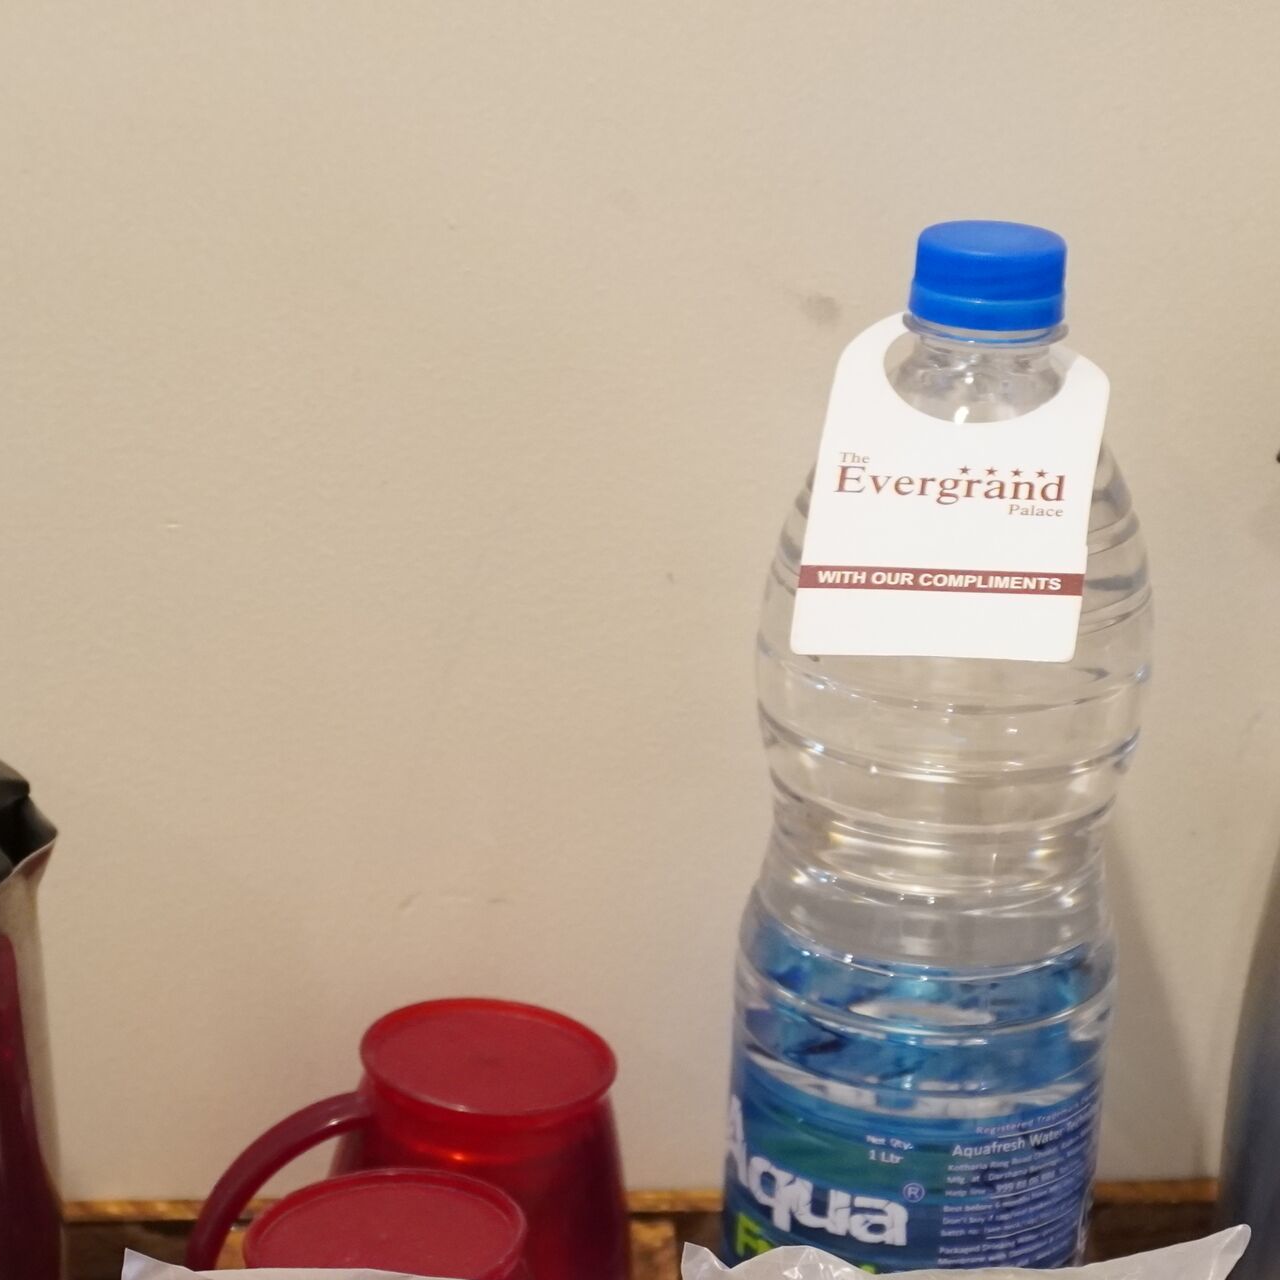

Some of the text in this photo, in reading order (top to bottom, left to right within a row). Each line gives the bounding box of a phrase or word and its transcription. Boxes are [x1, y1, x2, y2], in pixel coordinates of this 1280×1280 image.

[840, 451, 870, 464] The
[834, 464, 1066, 505] Evergrand
[1008, 504, 1064, 518] Palace
[817, 570, 1062, 591] WITH OUR COMPLIMENTS
[952, 1137, 1025, 1158] Aquafresh
[1029, 1128, 1064, 1147] Water
